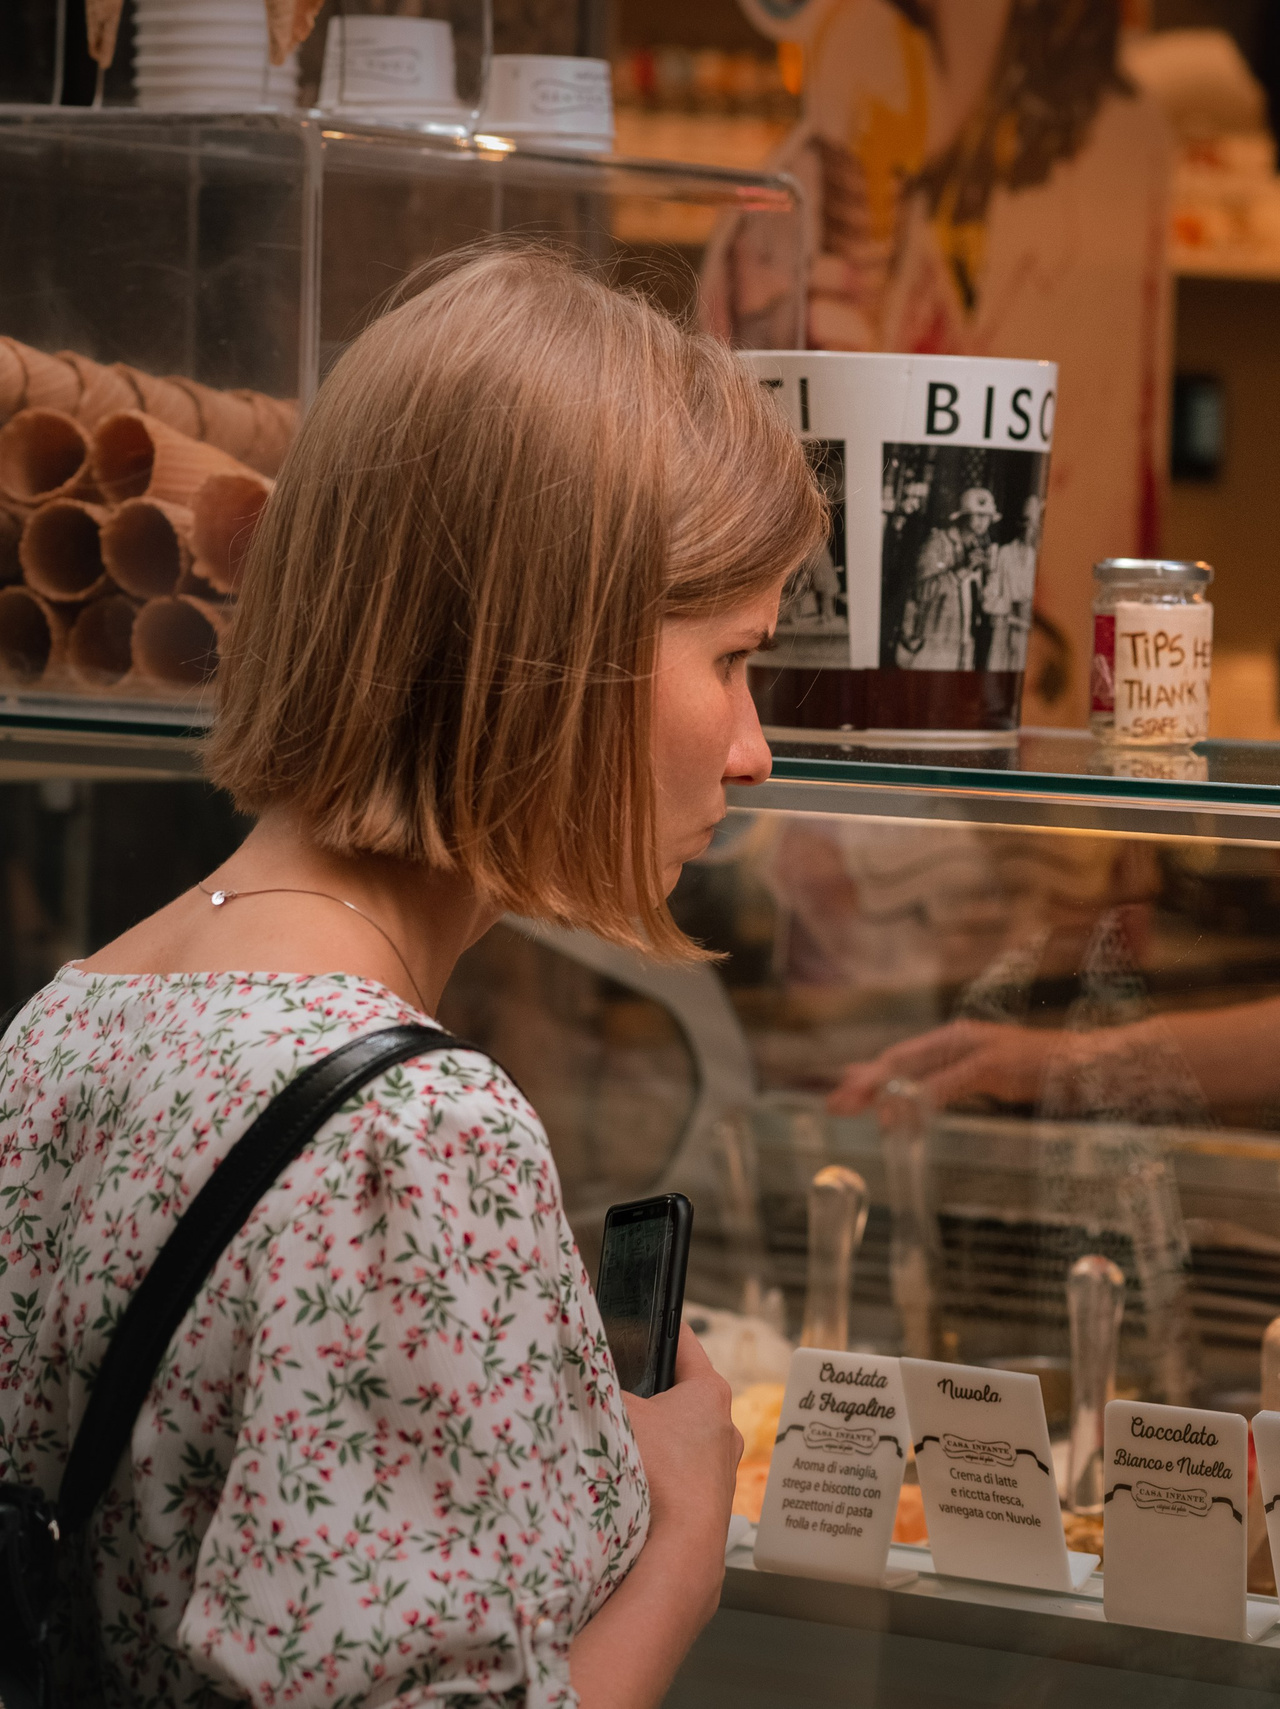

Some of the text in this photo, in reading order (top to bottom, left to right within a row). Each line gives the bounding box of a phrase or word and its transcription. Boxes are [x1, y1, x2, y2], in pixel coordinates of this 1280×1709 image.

[937, 1378, 1002, 1403] Nuvola
[799, 1390, 896, 1422] di Fragoline
[1131, 1416, 1219, 1447] Cioccolato
[792, 1457, 825, 1473] Aroma
[827, 1460, 838, 1474] di
[1113, 1448, 1233, 1480] Bianco e Nutella
[782, 1477, 881, 1499] strega e biscotto con
[949, 1467, 1018, 1488] Crema di latte
[950, 1487, 957, 1497] e
[992, 1490, 1024, 1508] fresca,
[1139, 1488, 1205, 1503] CASA INFANTE
[782, 1497, 873, 1518] pezzettoni di pasta
[785, 1514, 863, 1537] frolla e fragoline
[986, 1510, 1004, 1521] con
[1005, 1511, 1041, 1527] Nuvole
